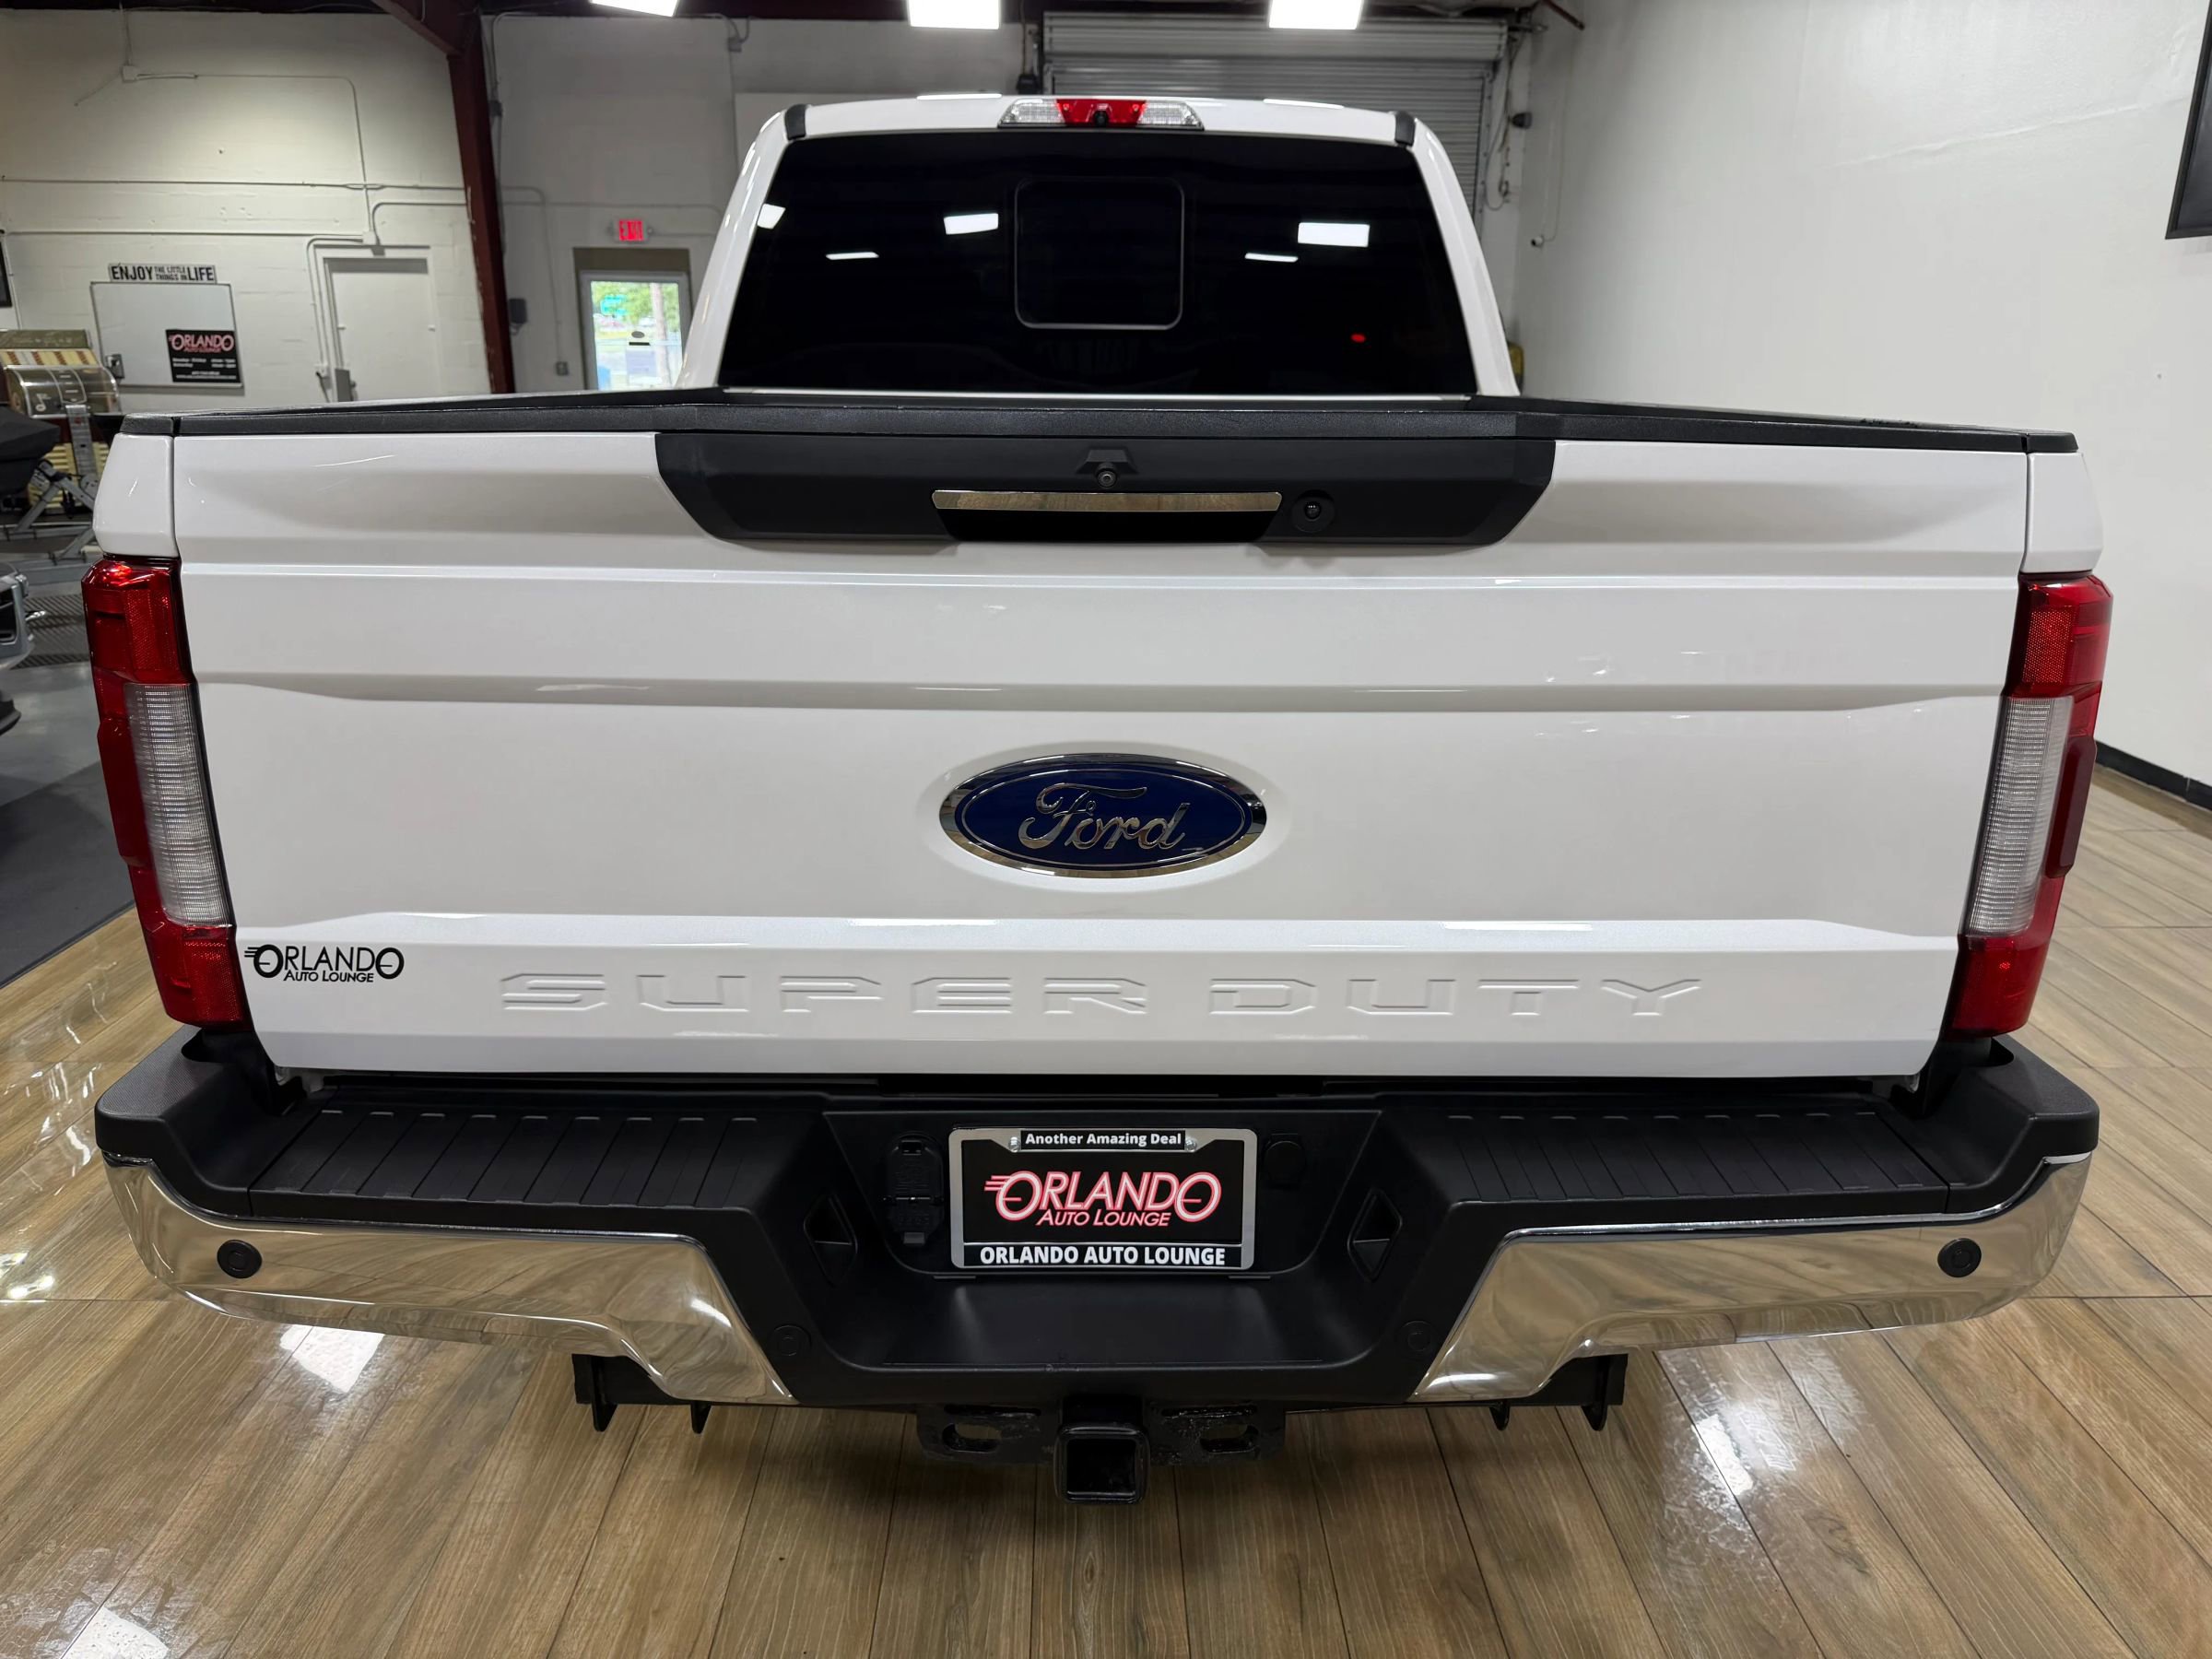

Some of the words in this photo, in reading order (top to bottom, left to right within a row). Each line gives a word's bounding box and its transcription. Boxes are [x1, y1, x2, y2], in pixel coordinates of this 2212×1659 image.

[112, 265, 153, 280] ENJOY
[187, 266, 215, 281] LIFE
[169, 334, 234, 351] ORLANDO
[1018, 782, 1191, 849] Ford
[244, 944, 405, 980] ORLANDO
[283, 970, 319, 982] AUTO
[323, 970, 374, 982] LOUNGE
[500, 973, 1147, 1014] SUPER
[1209, 978, 1702, 1016] DUTY
[1025, 1133, 1083, 1145] Another
[1087, 1133, 1147, 1147] Amazing
[1150, 1133, 1182, 1145] Deal
[984, 1171, 1222, 1222] ORLANDO
[1036, 1209, 1090, 1227] AUTO
[1092, 1208, 1171, 1228] LOUNGE
[980, 1246, 1079, 1265] ORLANDO
[1083, 1247, 1139, 1265] AUTO
[1144, 1247, 1226, 1265] LOUNGE
